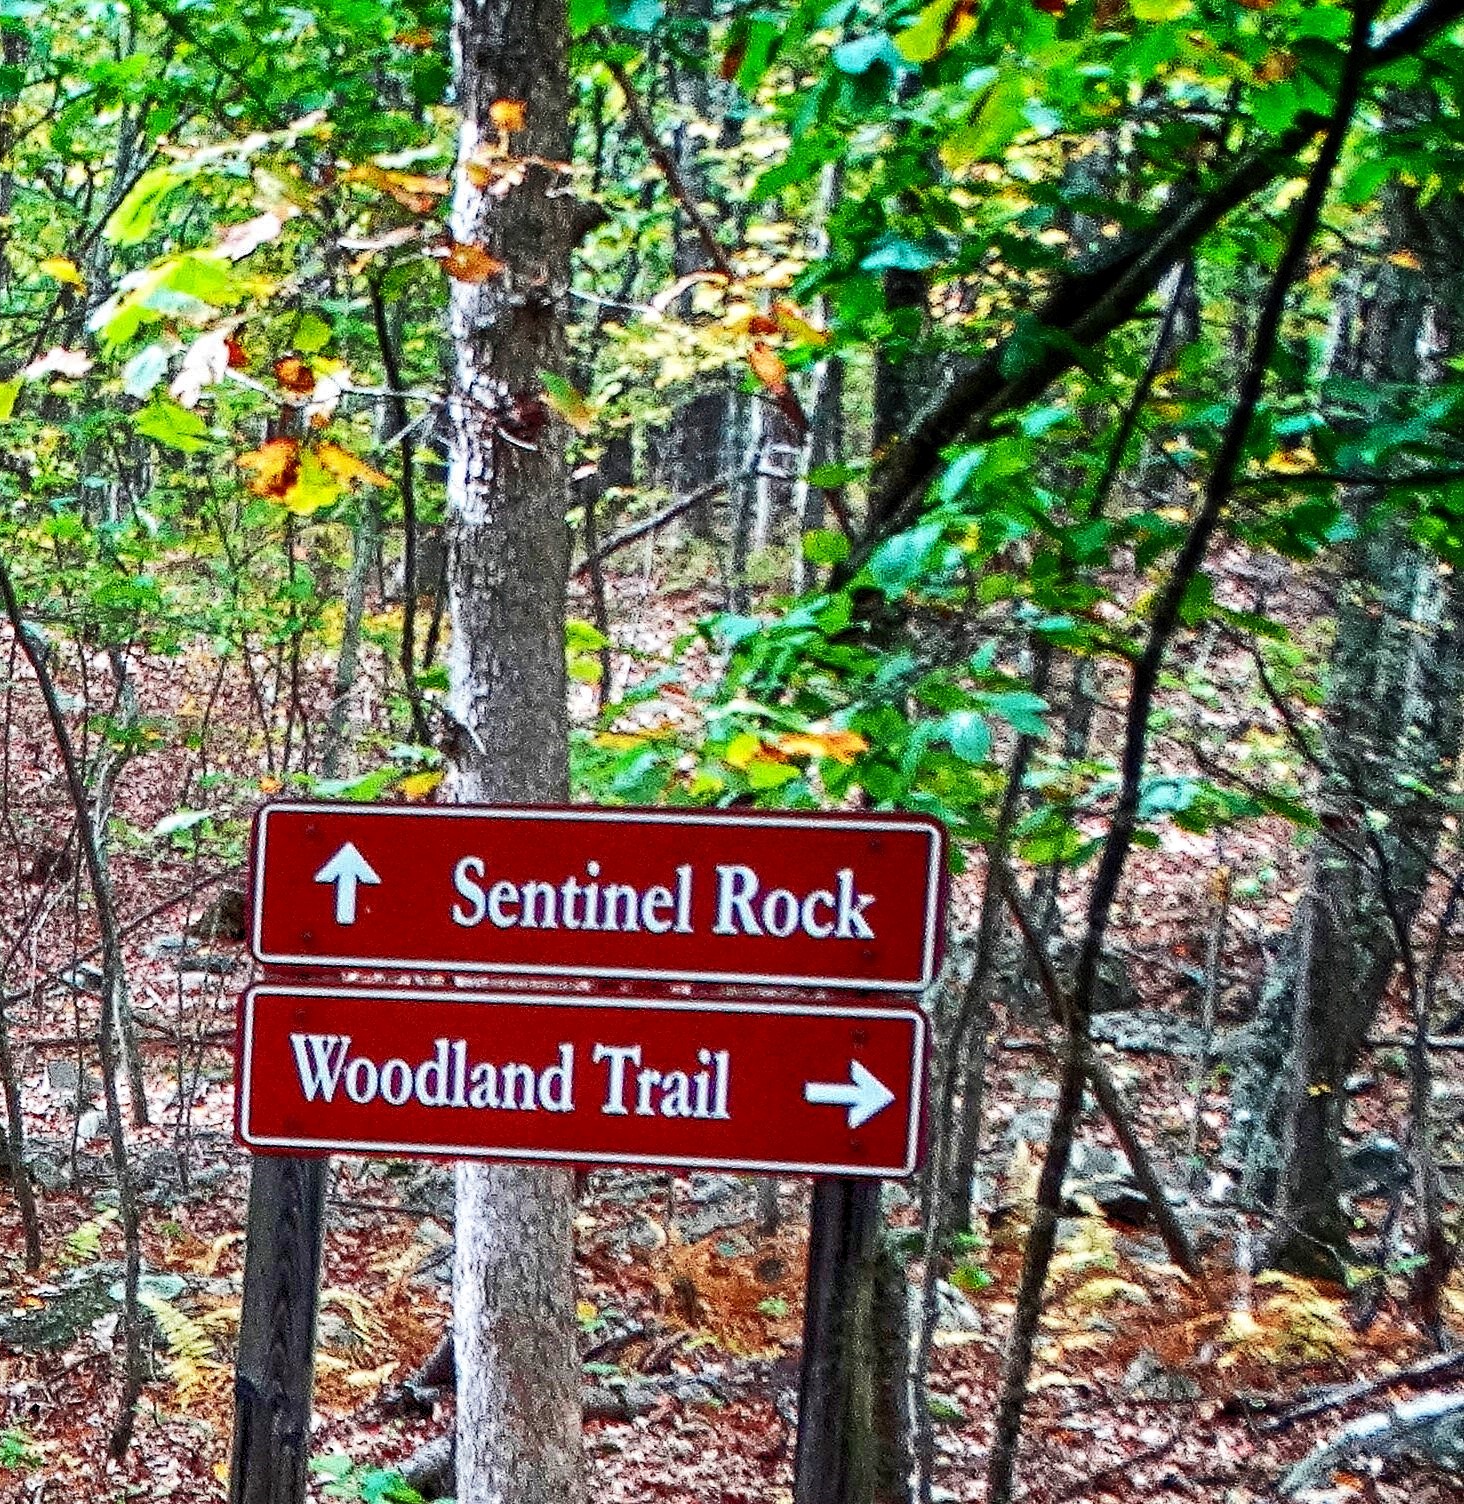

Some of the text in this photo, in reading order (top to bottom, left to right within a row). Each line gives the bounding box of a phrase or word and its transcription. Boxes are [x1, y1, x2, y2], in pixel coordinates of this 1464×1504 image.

[451, 855, 876, 941] Sentinel Rock
[289, 1032, 731, 1121] Woodland Trail
